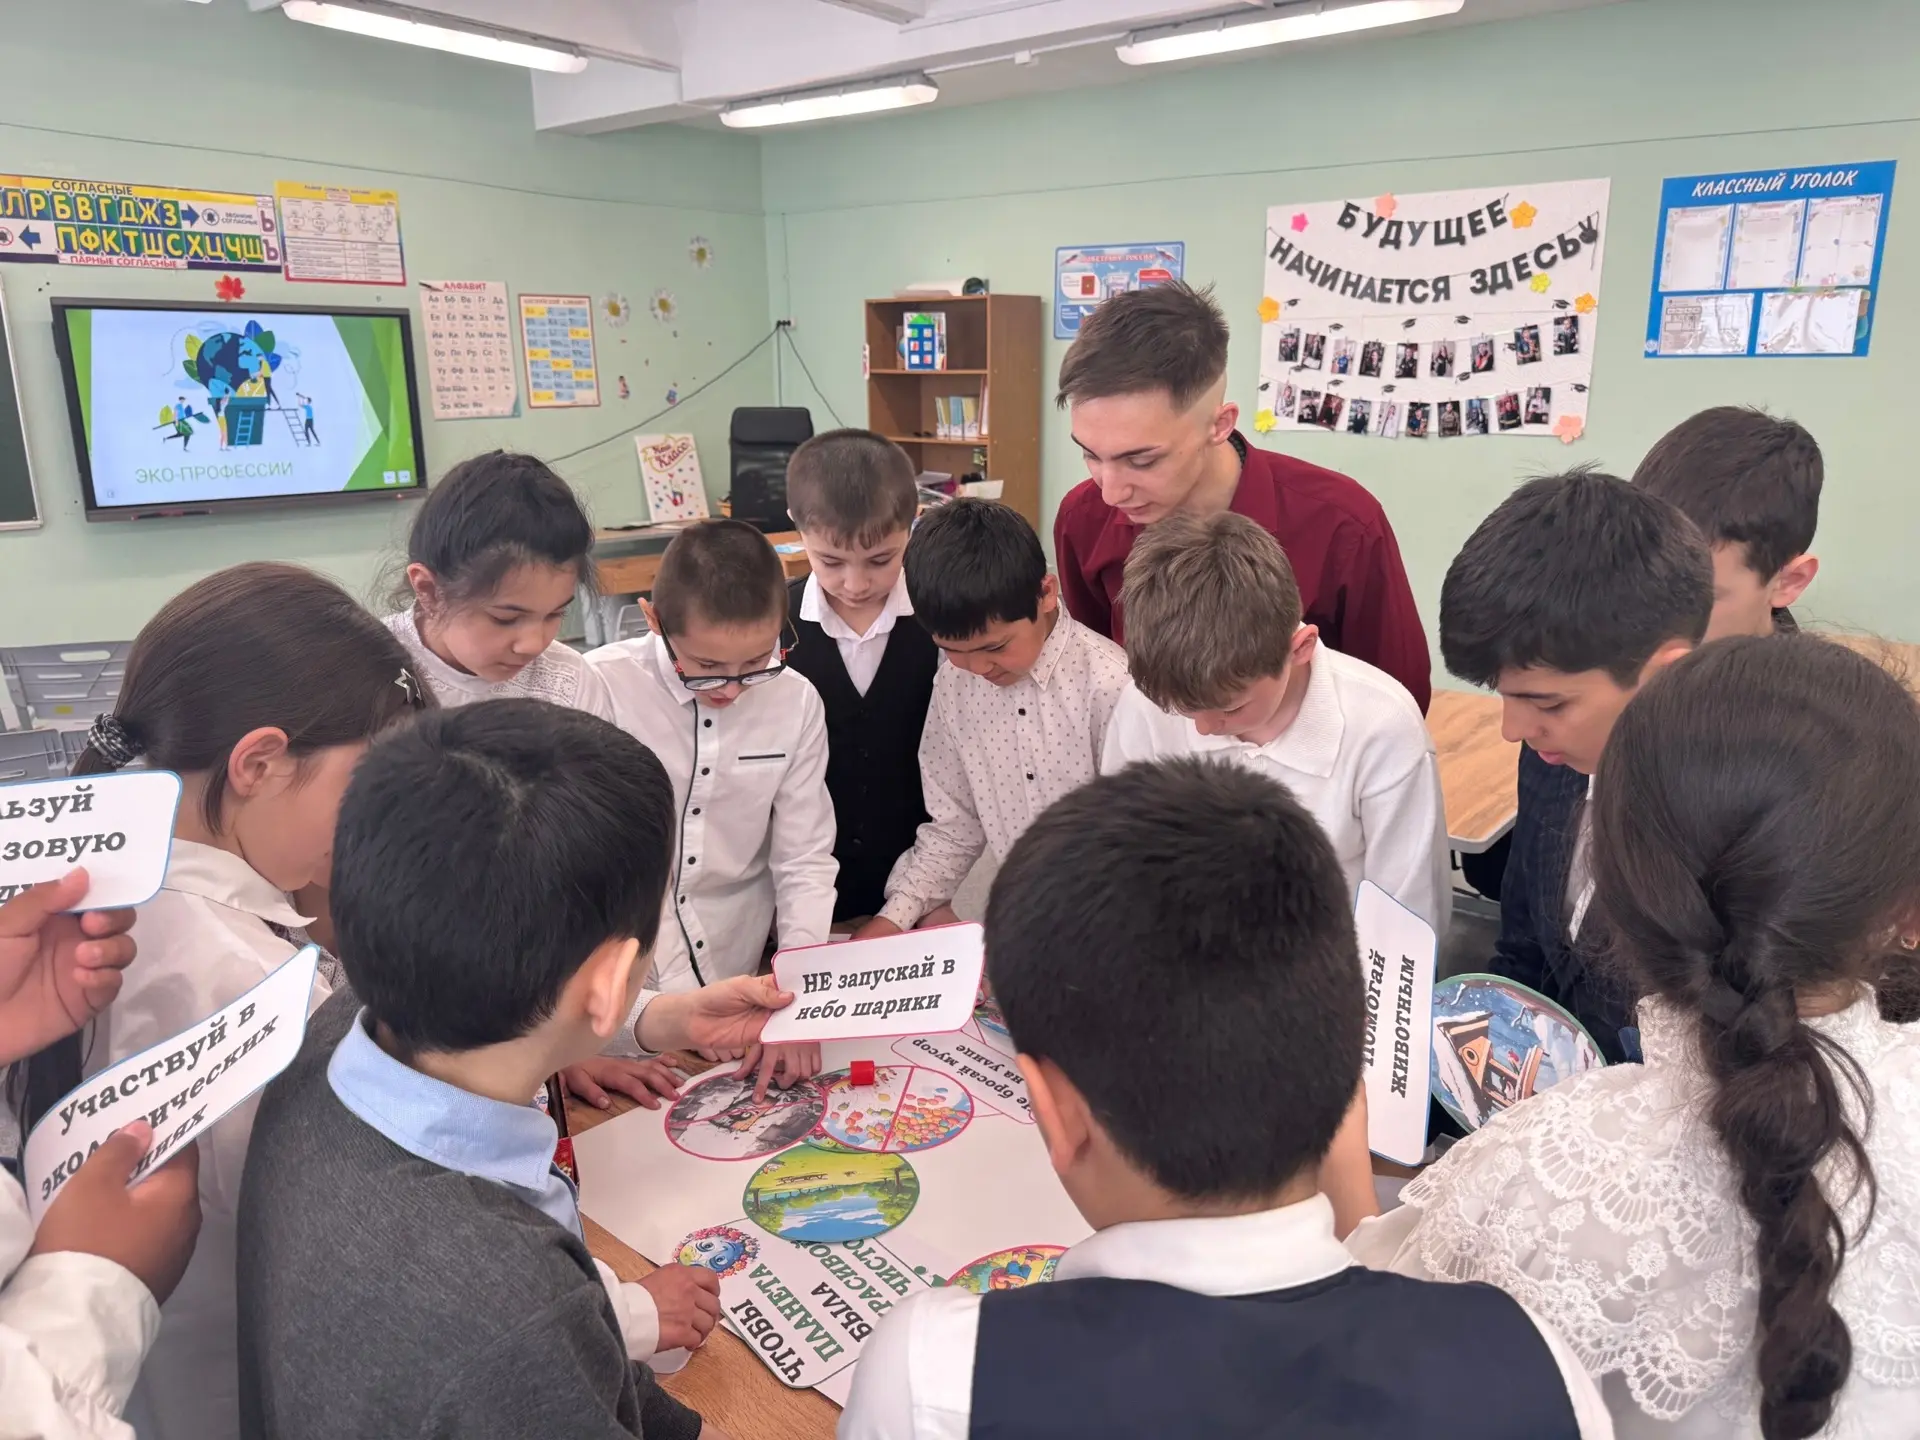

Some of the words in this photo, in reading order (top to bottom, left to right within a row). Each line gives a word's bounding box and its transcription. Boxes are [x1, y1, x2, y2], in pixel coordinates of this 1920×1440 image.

[52, 180, 133, 196] СОГЛАСНЫЕ
[1691, 171, 1787, 198] КЛАССНЫЙ
[1790, 169, 1859, 191] УГОЛОК
[1336, 197, 1509, 251] БУДУЩЕЕ
[70, 255, 113, 265] ПАРНЫЕ
[116, 256, 177, 268] СОГЛАСНЫЕ
[1268, 236, 1452, 305] НАЧИНАЕТСЯ
[1469, 232, 1581, 296] ЗДЕСЬ
[443, 282, 487, 291] АЛФАВИТ
[135, 461, 294, 485] ЭКО-ПРОФЕССИИ
[802, 971, 833, 994] НЕ
[837, 954, 936, 991] запускай
[941, 958, 956, 975] в
[238, 1002, 256, 1028] в
[794, 998, 847, 1021] небо
[850, 993, 942, 1019] шарики
[912, 1038, 959, 1067] мусор
[955, 1044, 1005, 1073] улице
[958, 1064, 1014, 1099] бросай
[1004, 1069, 1025, 1085] на
[748, 1262, 845, 1363] ПЛАНЕТА
[810, 1281, 874, 1343] БЫЛА
[730, 1298, 805, 1384] ЧТОБЫ
